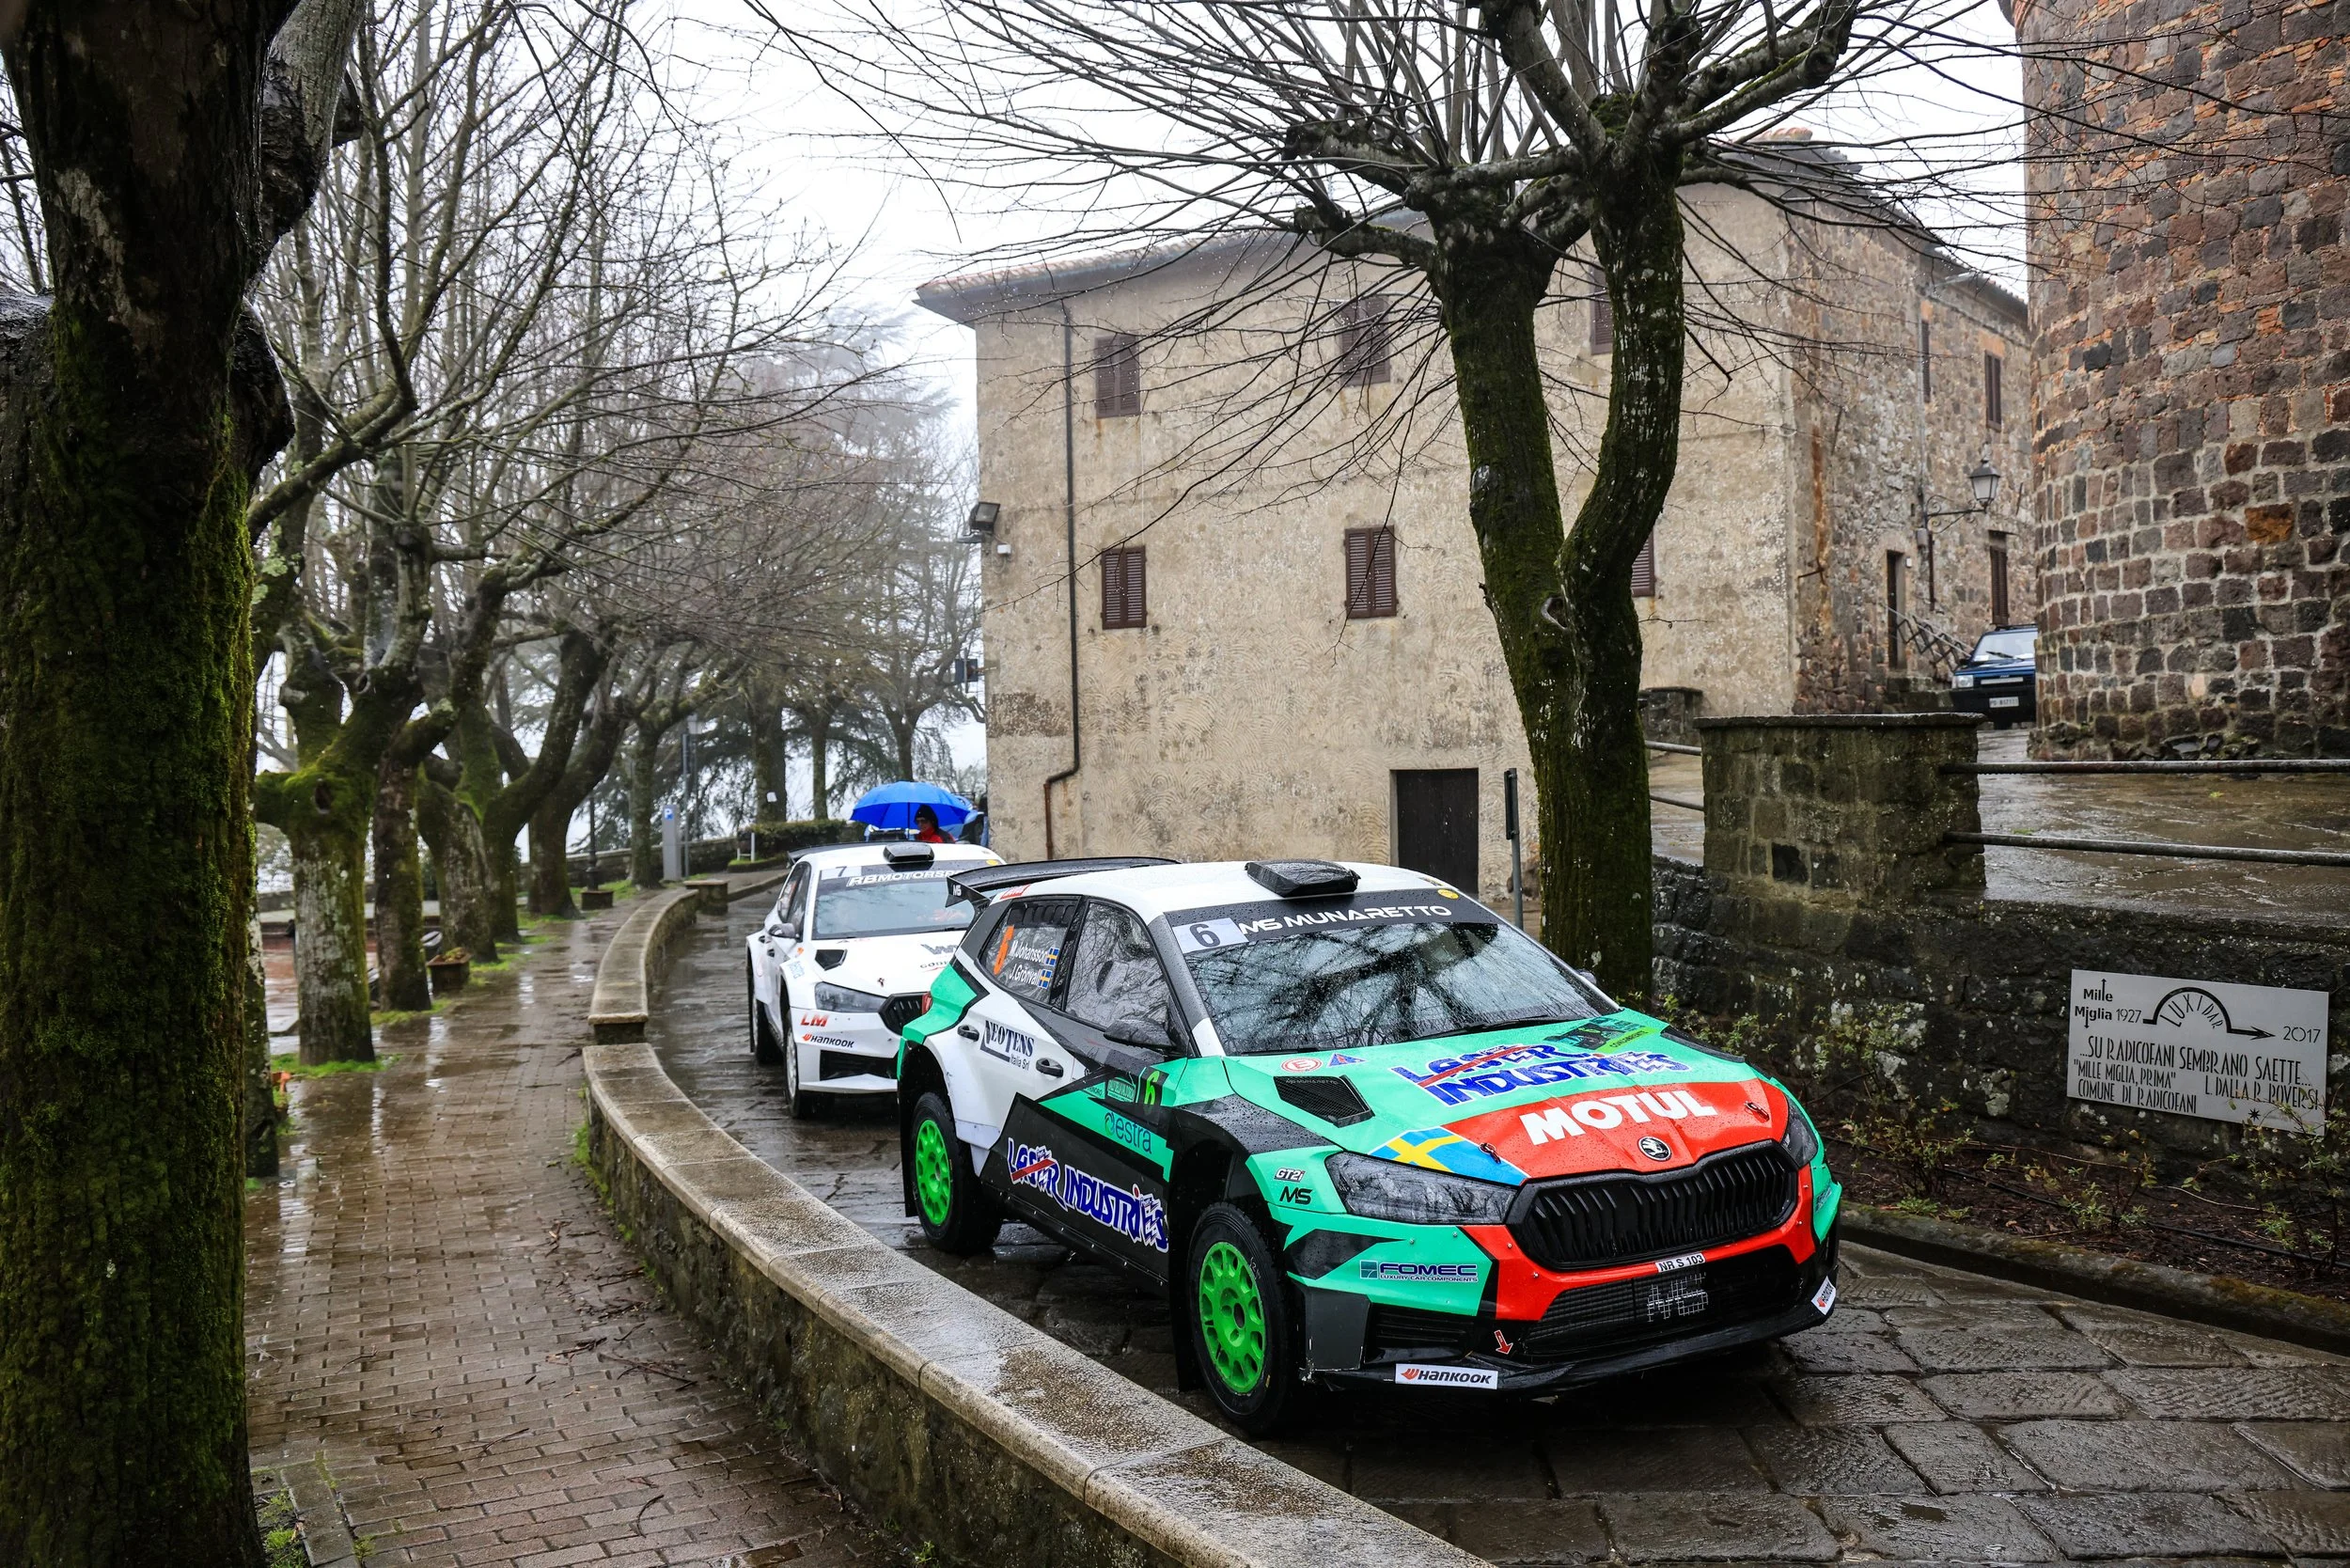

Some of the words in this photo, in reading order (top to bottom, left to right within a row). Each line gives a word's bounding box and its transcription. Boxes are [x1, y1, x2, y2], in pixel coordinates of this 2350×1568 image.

[836, 866, 847, 877] 7
[1238, 918, 1282, 936] MS
[1283, 905, 1452, 929] MUNARETTO
[1189, 923, 1221, 948] 6
[994, 925, 1015, 976] 6
[2083, 986, 2113, 1002] Mille
[800, 1013, 829, 1027] LM
[2075, 1005, 2112, 1022] Miglia
[2115, 1008, 2142, 1024] 1927
[984, 1020, 1035, 1058] NEOTENS
[2282, 1026, 2321, 1043] 2017
[2107, 1037, 2175, 1068] RADICOFANI
[2179, 1046, 2248, 1077] SEMBRANO
[1144, 1071, 1161, 1112] 6
[2077, 1078, 2115, 1102] COMUNE
[2122, 1084, 2131, 1104] DI
[2138, 1087, 2197, 1114] RADICOFANI
[1519, 1090, 1718, 1146] MOTUL
[1116, 1118, 1152, 1154] estra
[1274, 1168, 1306, 1183] GT2i
[1279, 1186, 1313, 1205] MS
[1379, 1262, 1478, 1278] FOMEC
[1658, 1260, 1674, 1272] NR
[1677, 1257, 1684, 1268] S
[1686, 1253, 1704, 1266] 103
